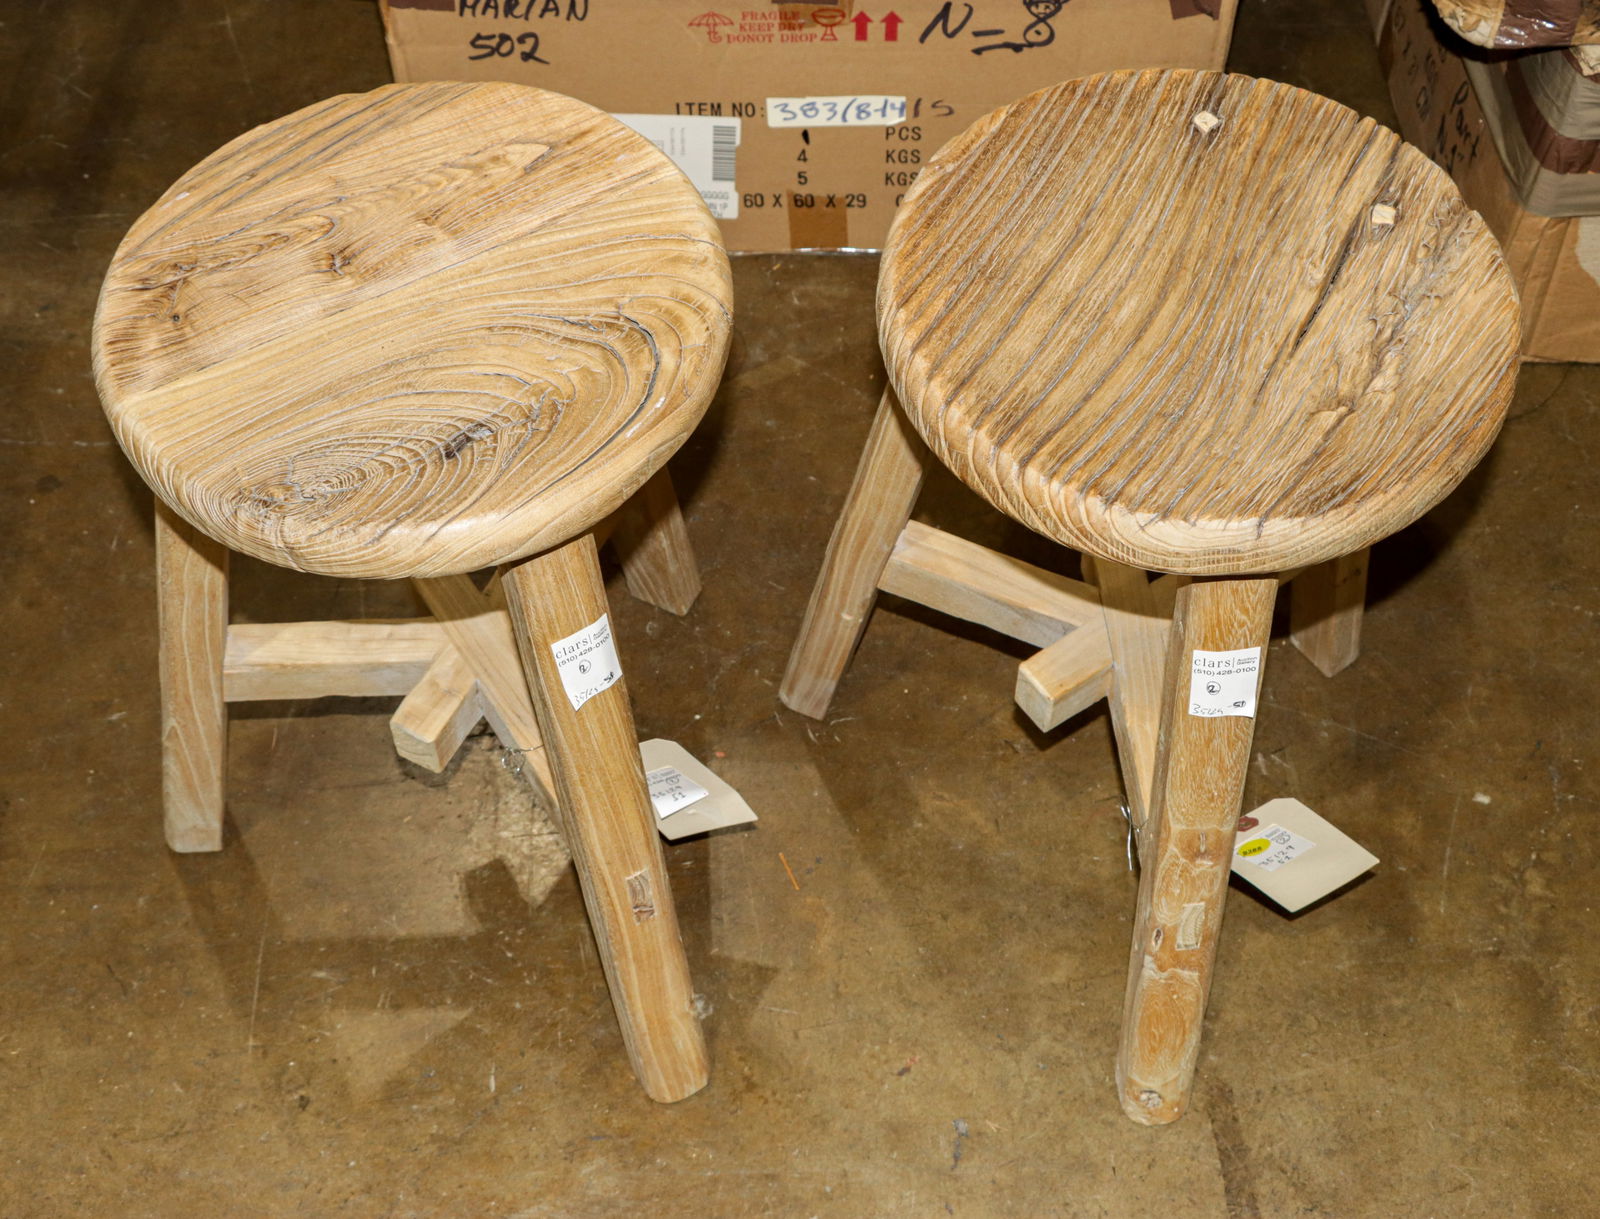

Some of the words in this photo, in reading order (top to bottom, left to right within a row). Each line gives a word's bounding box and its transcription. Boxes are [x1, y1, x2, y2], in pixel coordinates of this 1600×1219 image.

[741, 11, 800, 21] FRAGILE
[739, 22, 774, 32] KEEP
[777, 22, 804, 32] DRY
[727, 33, 774, 43] DONOT
[780, 33, 817, 43] DROP
[468, 32, 551, 65] 502
[675, 102, 721, 116] ITEM
[885, 126, 922, 141] PCS
[797, 149, 808, 163] 4
[885, 149, 921, 164] KGS
[797, 171, 808, 186] 5
[884, 171, 919, 187] KGS
[743, 193, 765, 208] 60
[772, 194, 783, 208] X
[793, 193, 815, 208] 60
[825, 194, 837, 208] X
[845, 193, 867, 208] 29
[555, 637, 590, 660] clars
[1194, 657, 1231, 668] clars
[1193, 668, 1216, 677] (510)
[1216, 666, 1257, 676] 428-0100
